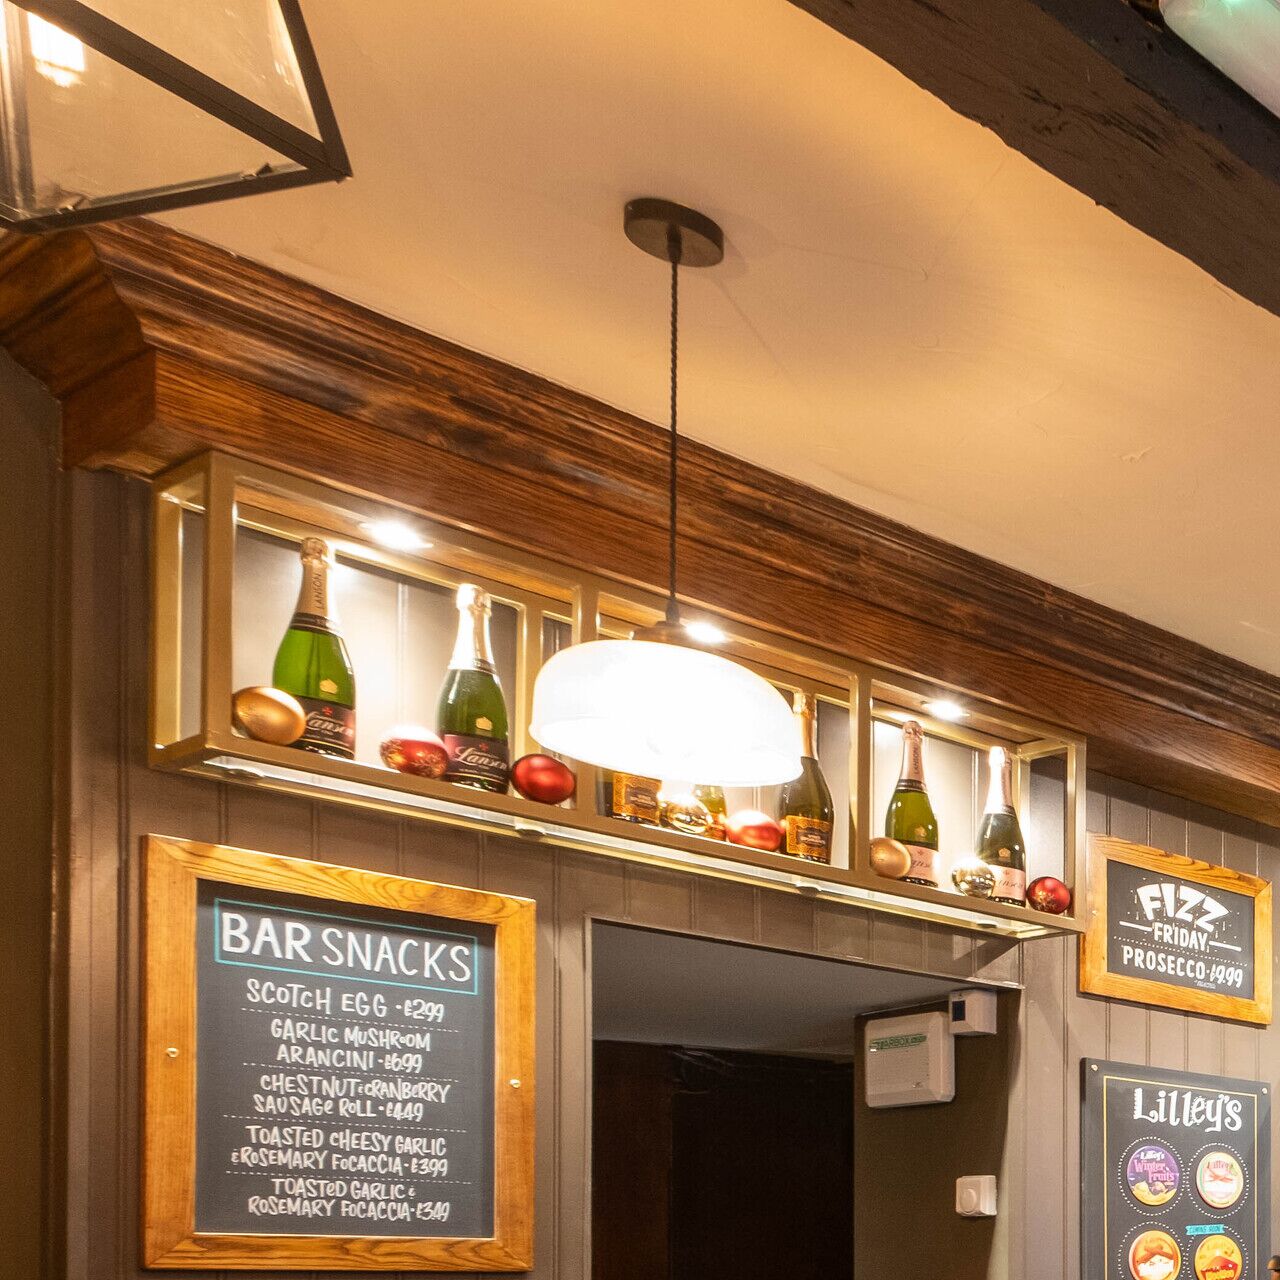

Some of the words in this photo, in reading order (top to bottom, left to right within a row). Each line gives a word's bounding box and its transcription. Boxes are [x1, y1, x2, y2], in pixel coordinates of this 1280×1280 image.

[315, 573, 326, 609] LANSON
[1136, 883, 1230, 932] FIZZ
[222, 912, 313, 962] BAR
[321, 927, 471, 982] SNACKS
[1153, 922, 1208, 951] FRIDAY
[1122, 945, 1206, 980] PROSECCO
[246, 978, 331, 1014] SCOTCH
[341, 992, 387, 1018] EGG
[270, 1018, 339, 1043] GARLIC
[344, 1026, 431, 1051] MUSHROOM
[276, 1044, 374, 1071] ARANCINI
[260, 1073, 361, 1098] CHESTNUT
[339, 1098, 377, 1118] ROLL
[1133, 1087, 1242, 1132] Lilley's
[245, 1125, 324, 1148] TOASTED
[329, 1128, 392, 1151] CHEESY
[394, 1135, 447, 1156] GARLIC
[240, 1146, 328, 1169] ROSEMARY
[332, 1153, 404, 1176] FOCACCIA
[1134, 1159, 1166, 1174] Winter
[350, 1180, 406, 1201] GARLIC
[248, 1195, 336, 1217] ROSEMARY
[341, 1200, 411, 1221] FOCACCIA
